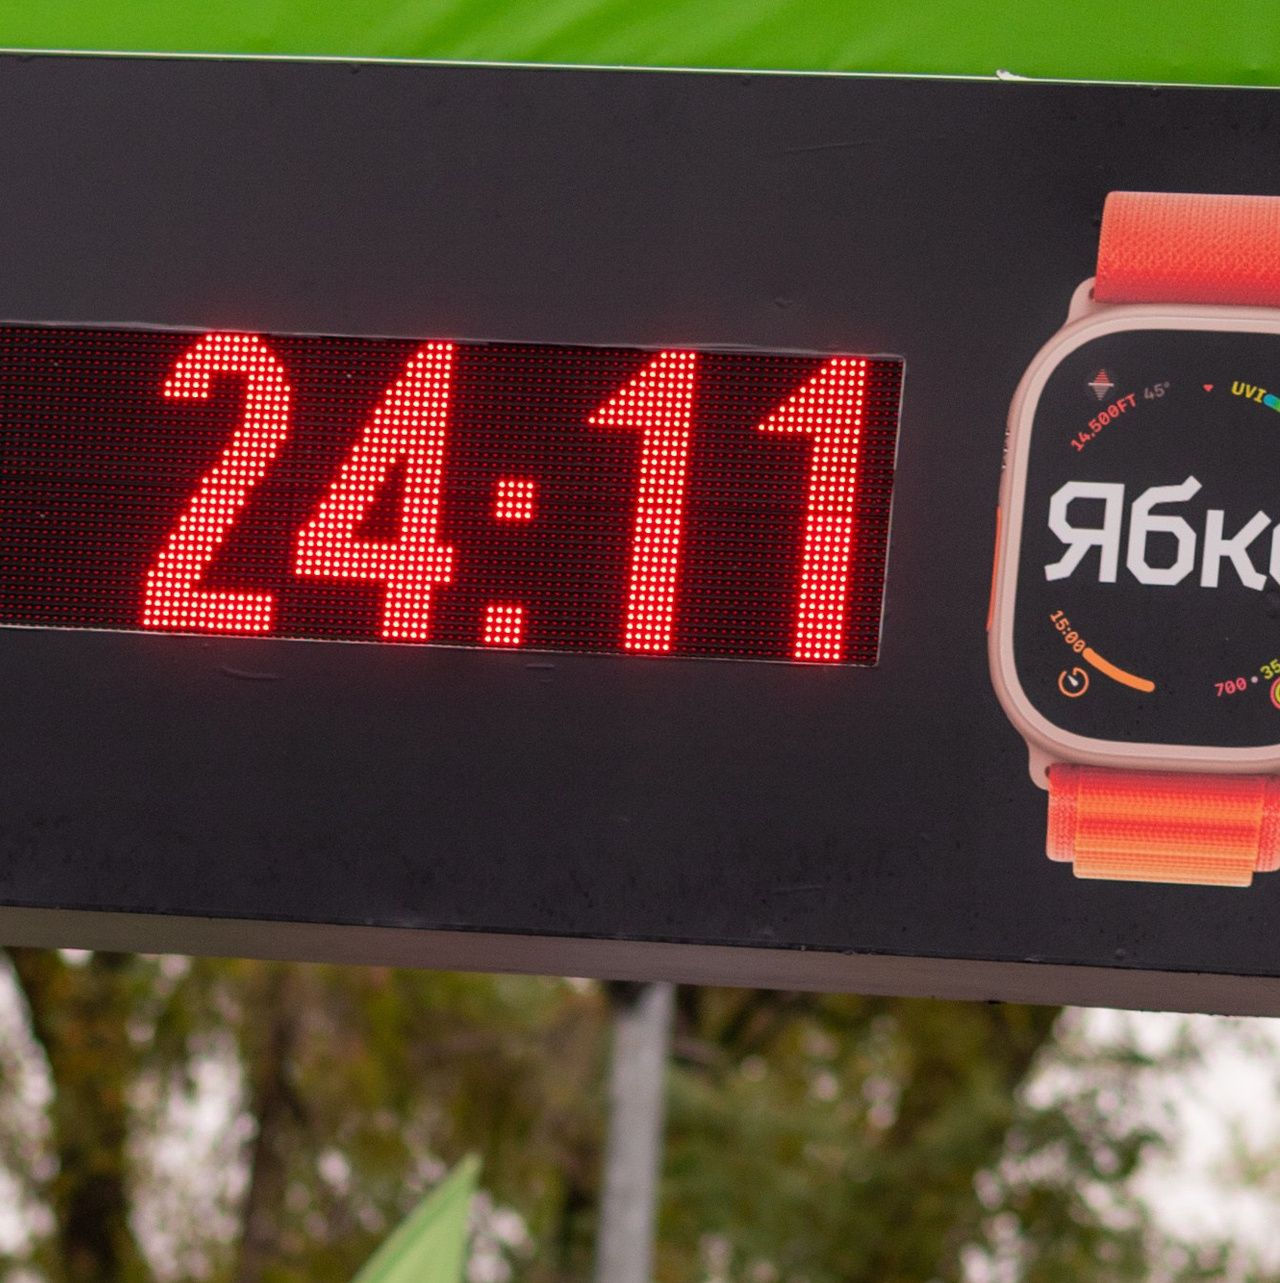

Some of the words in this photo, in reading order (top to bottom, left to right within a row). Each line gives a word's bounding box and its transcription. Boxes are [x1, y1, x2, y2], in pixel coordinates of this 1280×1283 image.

[1230, 380, 1267, 404] UVI
[141, 330, 868, 661] 24:11
[1044, 475, 1280, 591] Ябк
[1049, 609, 1086, 653] 15:00
[1213, 677, 1247, 697] 700
